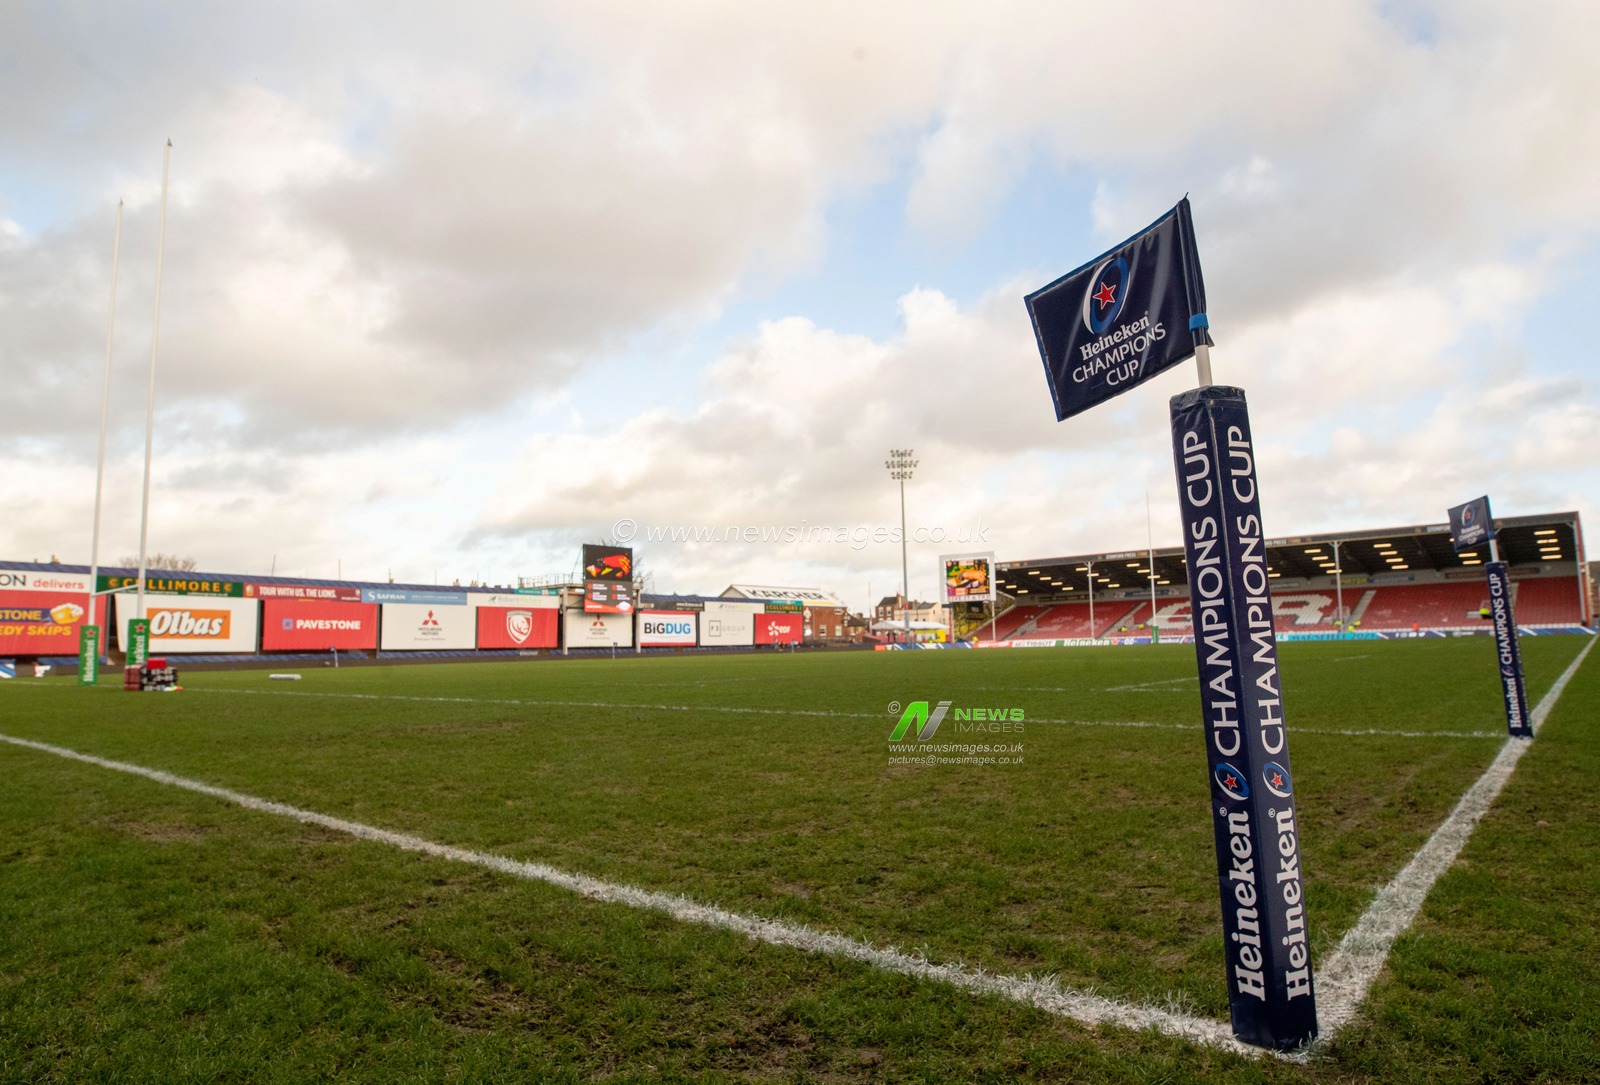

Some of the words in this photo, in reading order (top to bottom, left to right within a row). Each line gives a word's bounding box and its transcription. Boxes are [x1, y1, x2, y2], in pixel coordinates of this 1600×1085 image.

[1072, 322, 1167, 384] CHAMPIONS
[1079, 313, 1151, 361] Heineken
[1106, 359, 1140, 387] CUP
[1183, 430, 1213, 507] CUP
[1227, 425, 1255, 503] CUP
[33, 579, 84, 589] delivers
[122, 577, 221, 593] CLLIMORE
[259, 586, 277, 596] TOUR
[277, 587, 295, 596] WITH
[306, 588, 318, 597] THE
[1489, 573, 1503, 597] CUP
[27, 625, 72, 637] SKIPS
[149, 610, 224, 636] Olbas
[296, 619, 362, 630] PAVESTONE
[1063, 637, 1110, 647] Heineken
[1191, 516, 1241, 757] CHAMPIONS
[1236, 514, 1284, 755] CHAMPIONS
[1493, 598, 1513, 665] CHAMPIONS
[1506, 677, 1523, 729] Heineken
[1227, 810, 1266, 1002] Heineken
[1275, 806, 1311, 1001] Heineken
